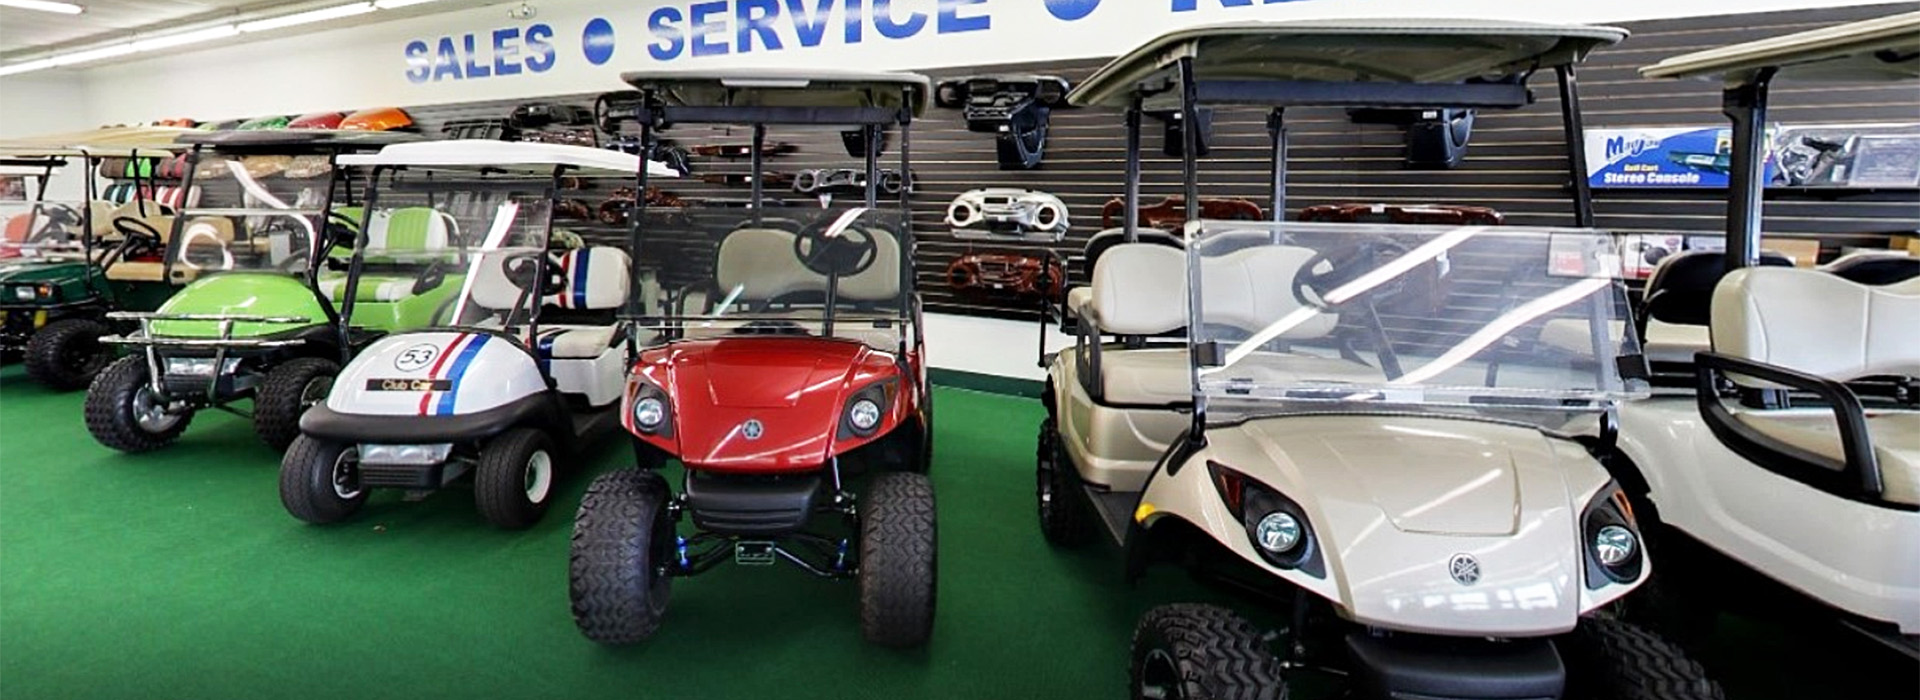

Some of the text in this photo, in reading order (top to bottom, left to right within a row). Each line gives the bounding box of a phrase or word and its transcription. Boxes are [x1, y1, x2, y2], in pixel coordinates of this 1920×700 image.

[405, 0, 990, 83] SALES SERVICE
[1604, 172, 1700, 184] Stereo Console
[400, 349, 432, 364] 53
[382, 379, 433, 390] Club Car
